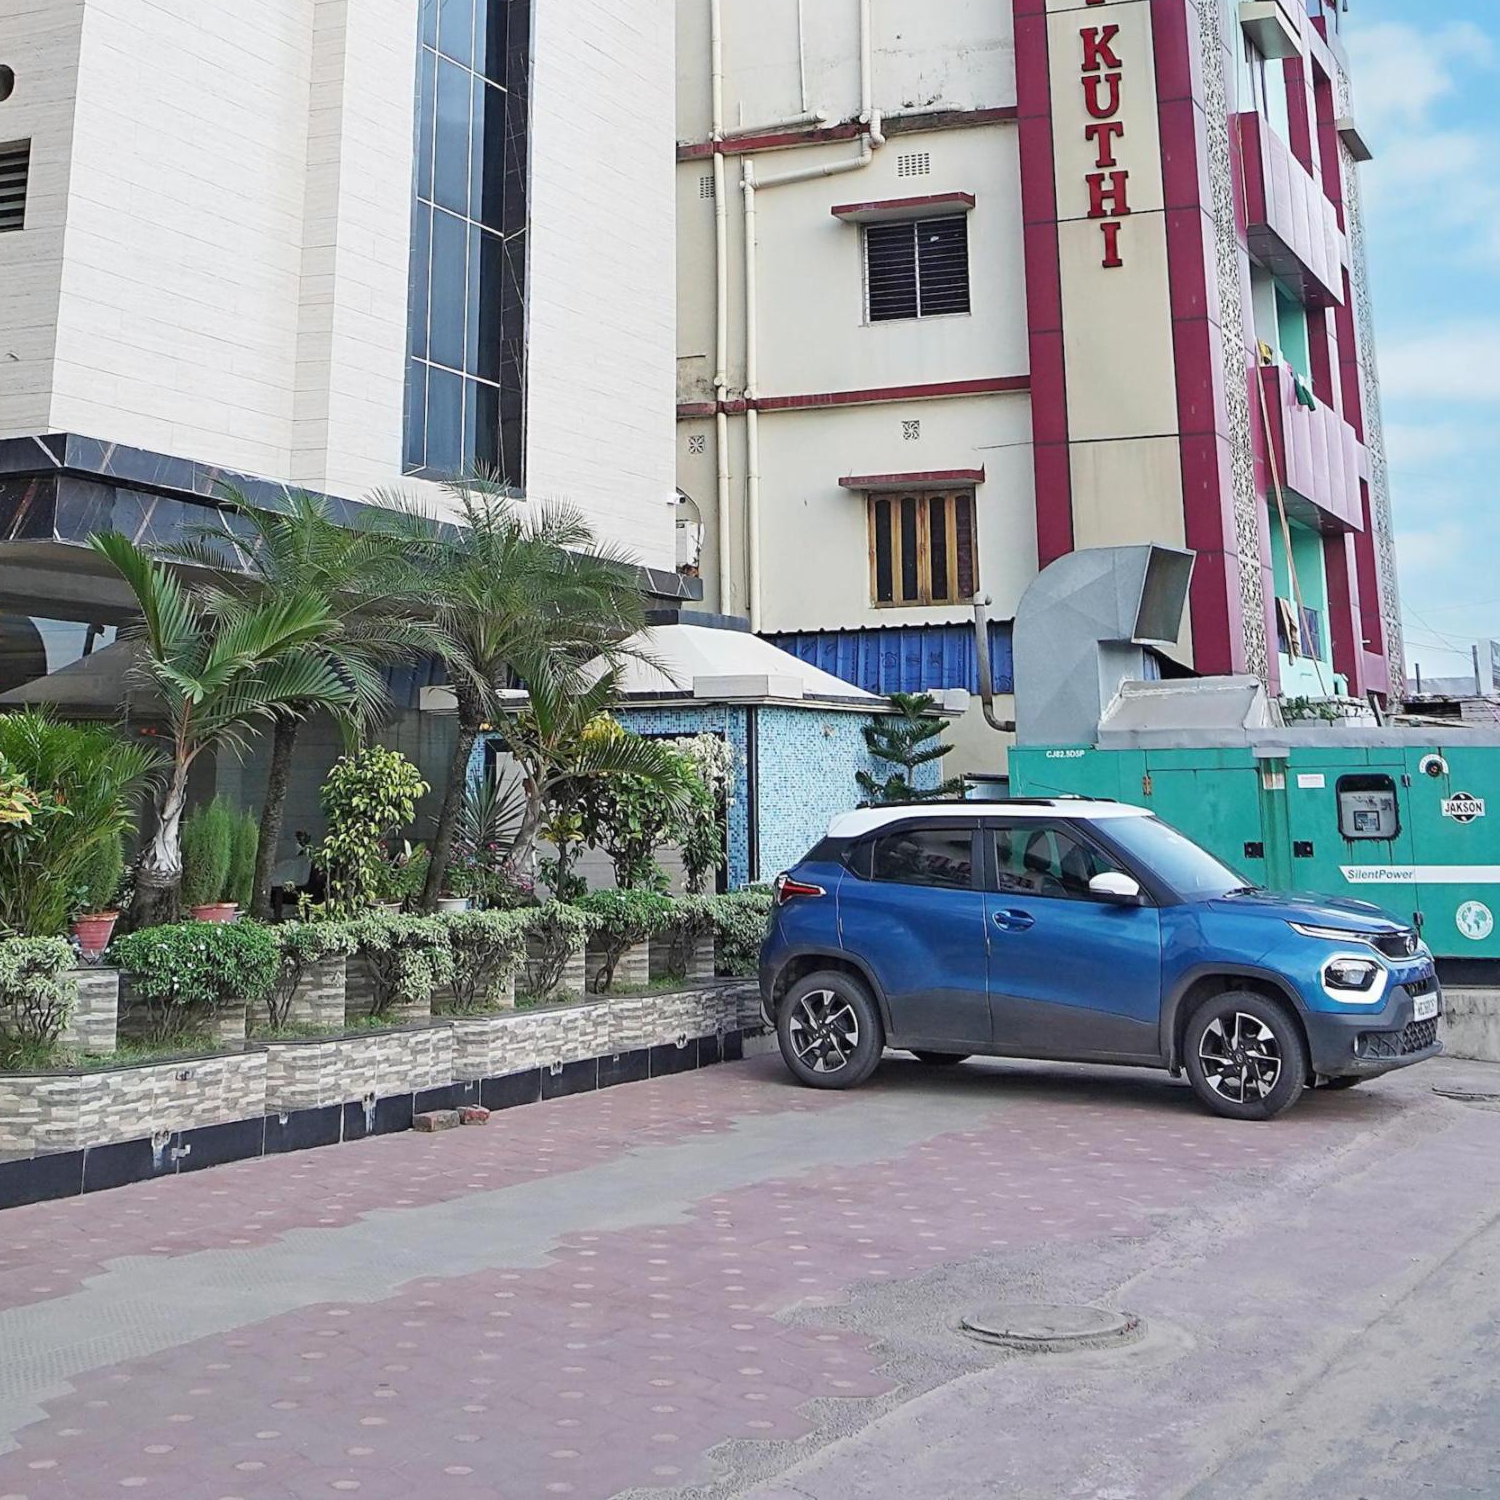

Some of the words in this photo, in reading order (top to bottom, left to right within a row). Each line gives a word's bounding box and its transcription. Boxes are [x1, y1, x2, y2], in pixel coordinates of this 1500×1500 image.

[1080, 24, 1132, 268] KUTHI
[1444, 802, 1482, 813] JAKSON
[1347, 869, 1413, 880] SilentPower
